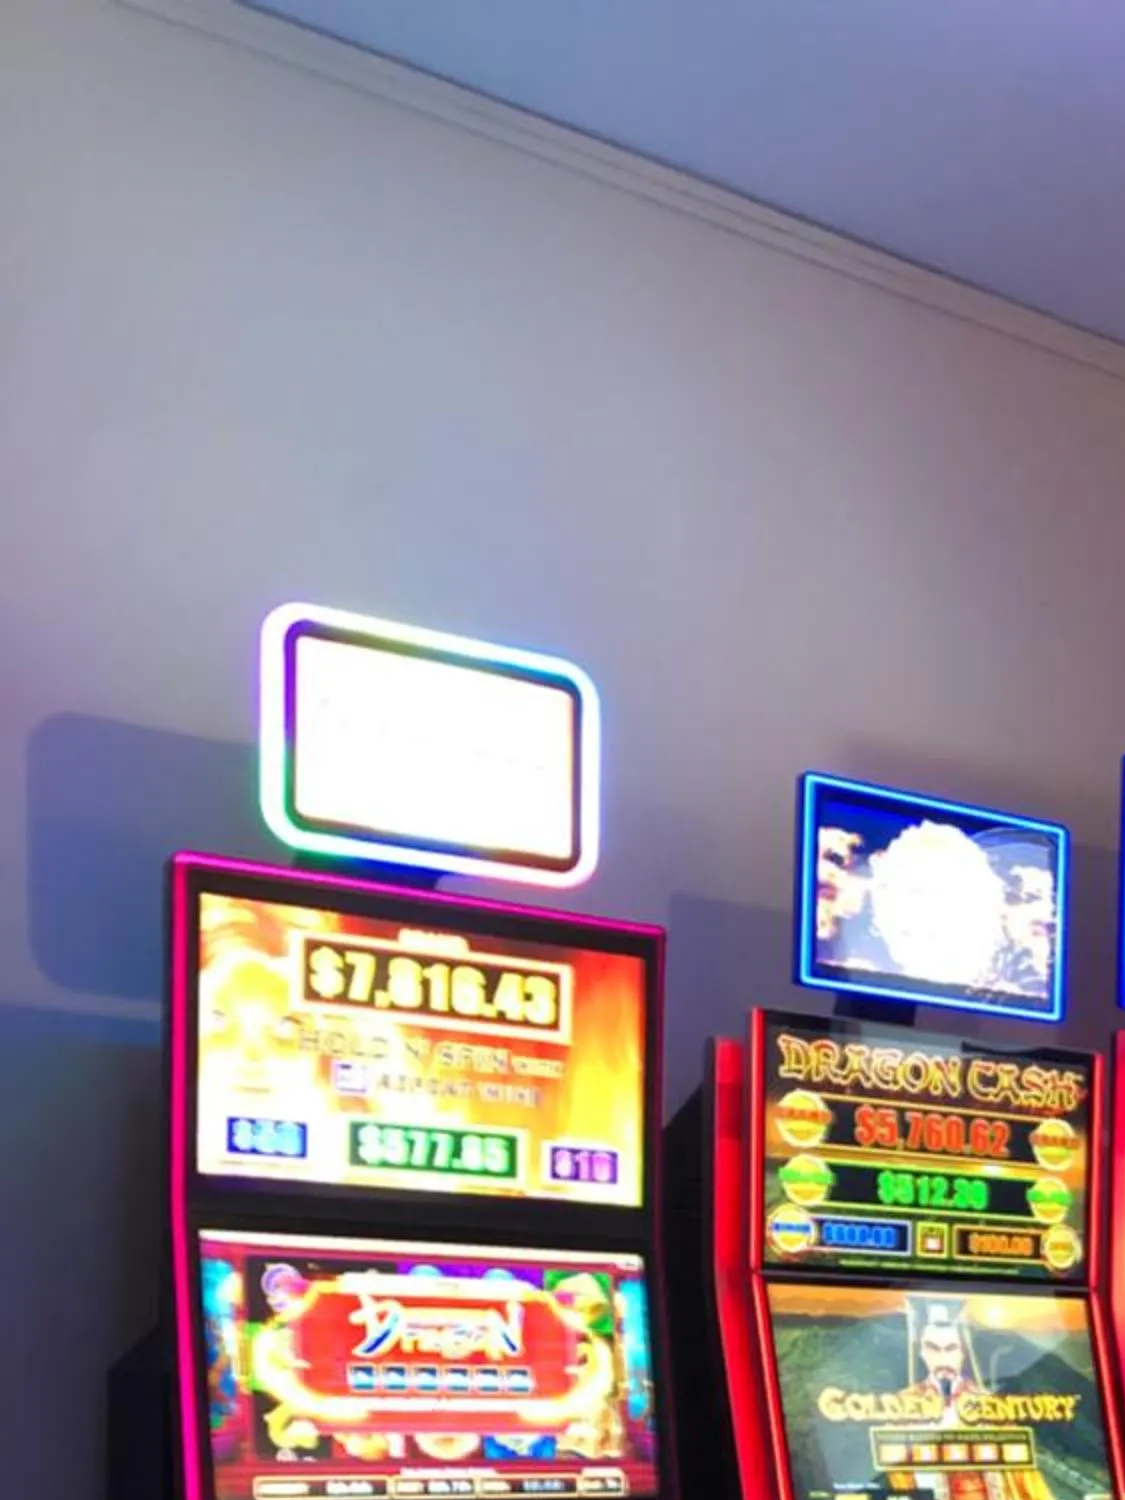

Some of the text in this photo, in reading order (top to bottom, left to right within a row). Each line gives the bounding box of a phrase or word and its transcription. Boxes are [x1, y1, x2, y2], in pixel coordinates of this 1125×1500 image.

[777, 1034, 1086, 1111] DRAGON CASH
[854, 1105, 1011, 1158] $5,760.62
[817, 1387, 1077, 1425] GOLDEN CENTURY
